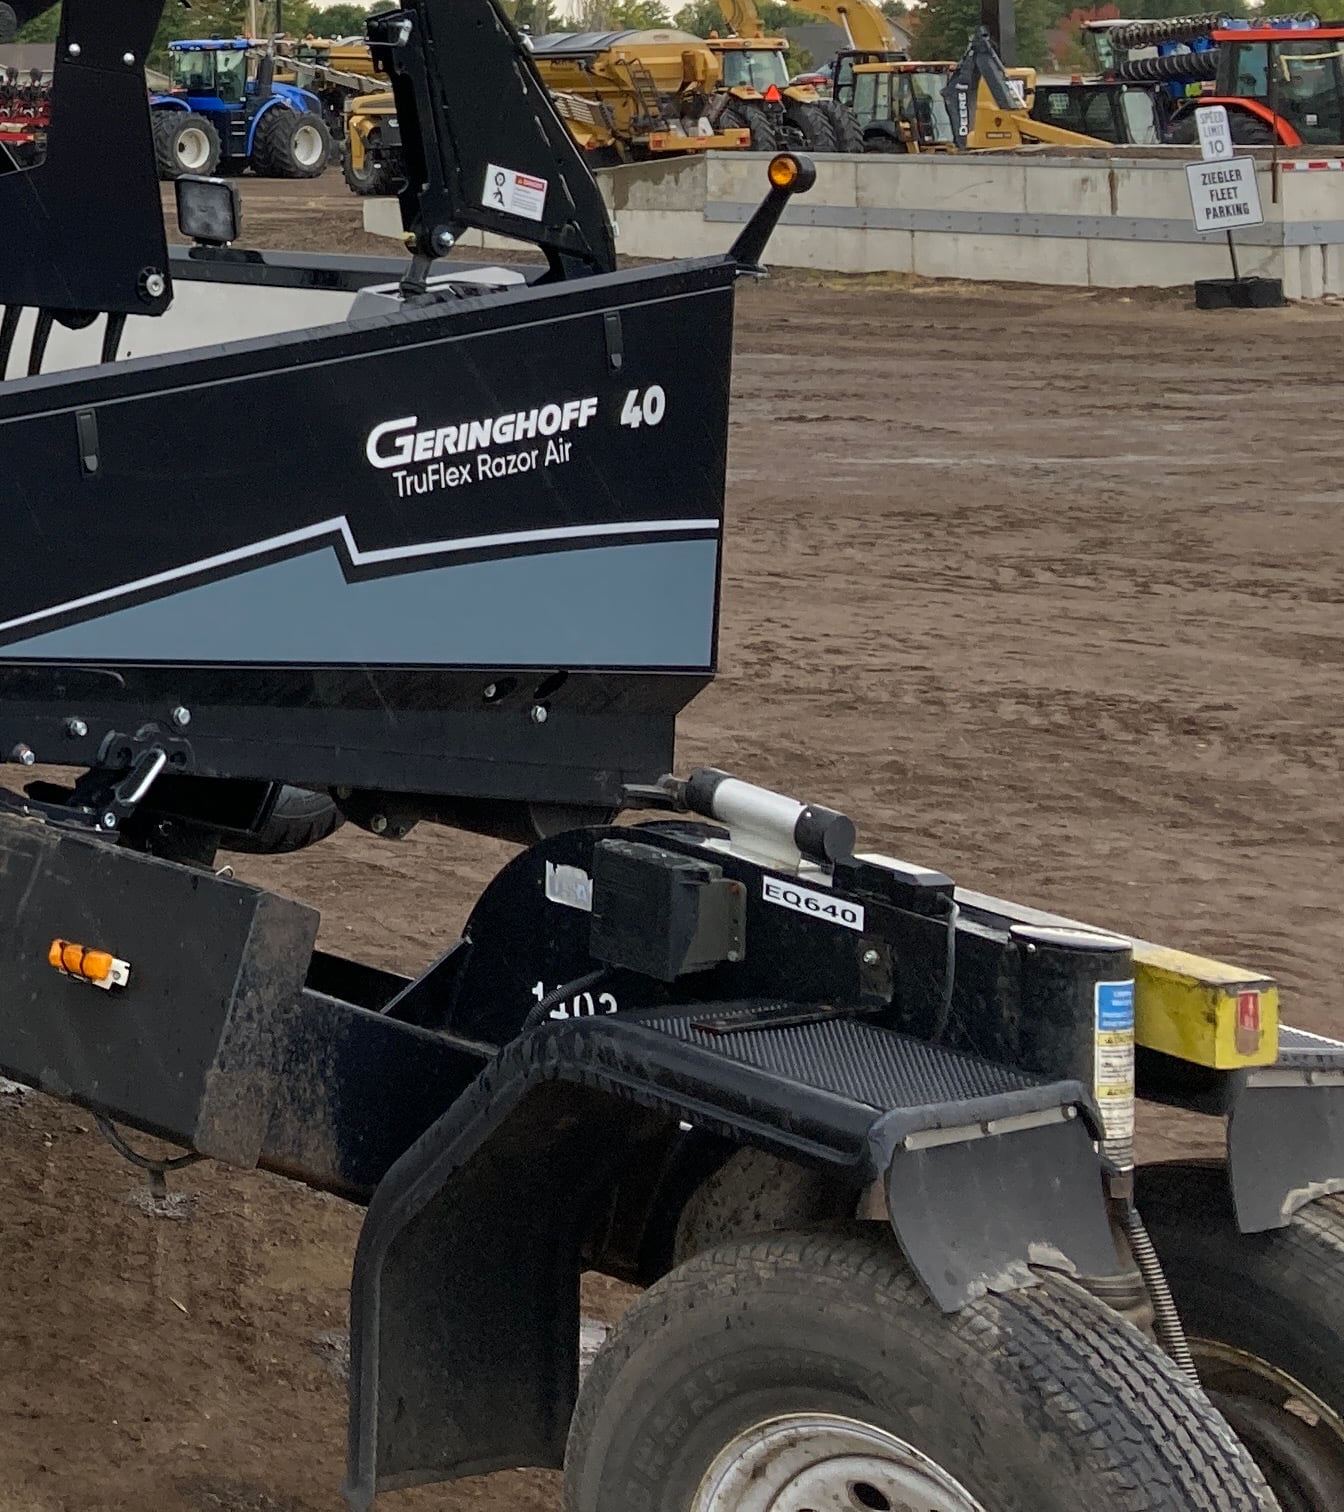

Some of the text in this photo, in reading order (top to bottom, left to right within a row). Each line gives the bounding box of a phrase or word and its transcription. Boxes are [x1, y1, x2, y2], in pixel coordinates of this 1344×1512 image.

[1199, 111, 1225, 125] SPEED
[1203, 125, 1225, 138] LIMIT
[1208, 139, 1225, 154] 10
[1201, 168, 1243, 186] ZIEGLER
[1209, 186, 1238, 202] FLEET
[1205, 202, 1250, 220] PARKING
[365, 384, 666, 470] GERINGHOFF 40
[392, 437, 573, 498] TruFlex Razor Air
[765, 882, 858, 925] EQ640
